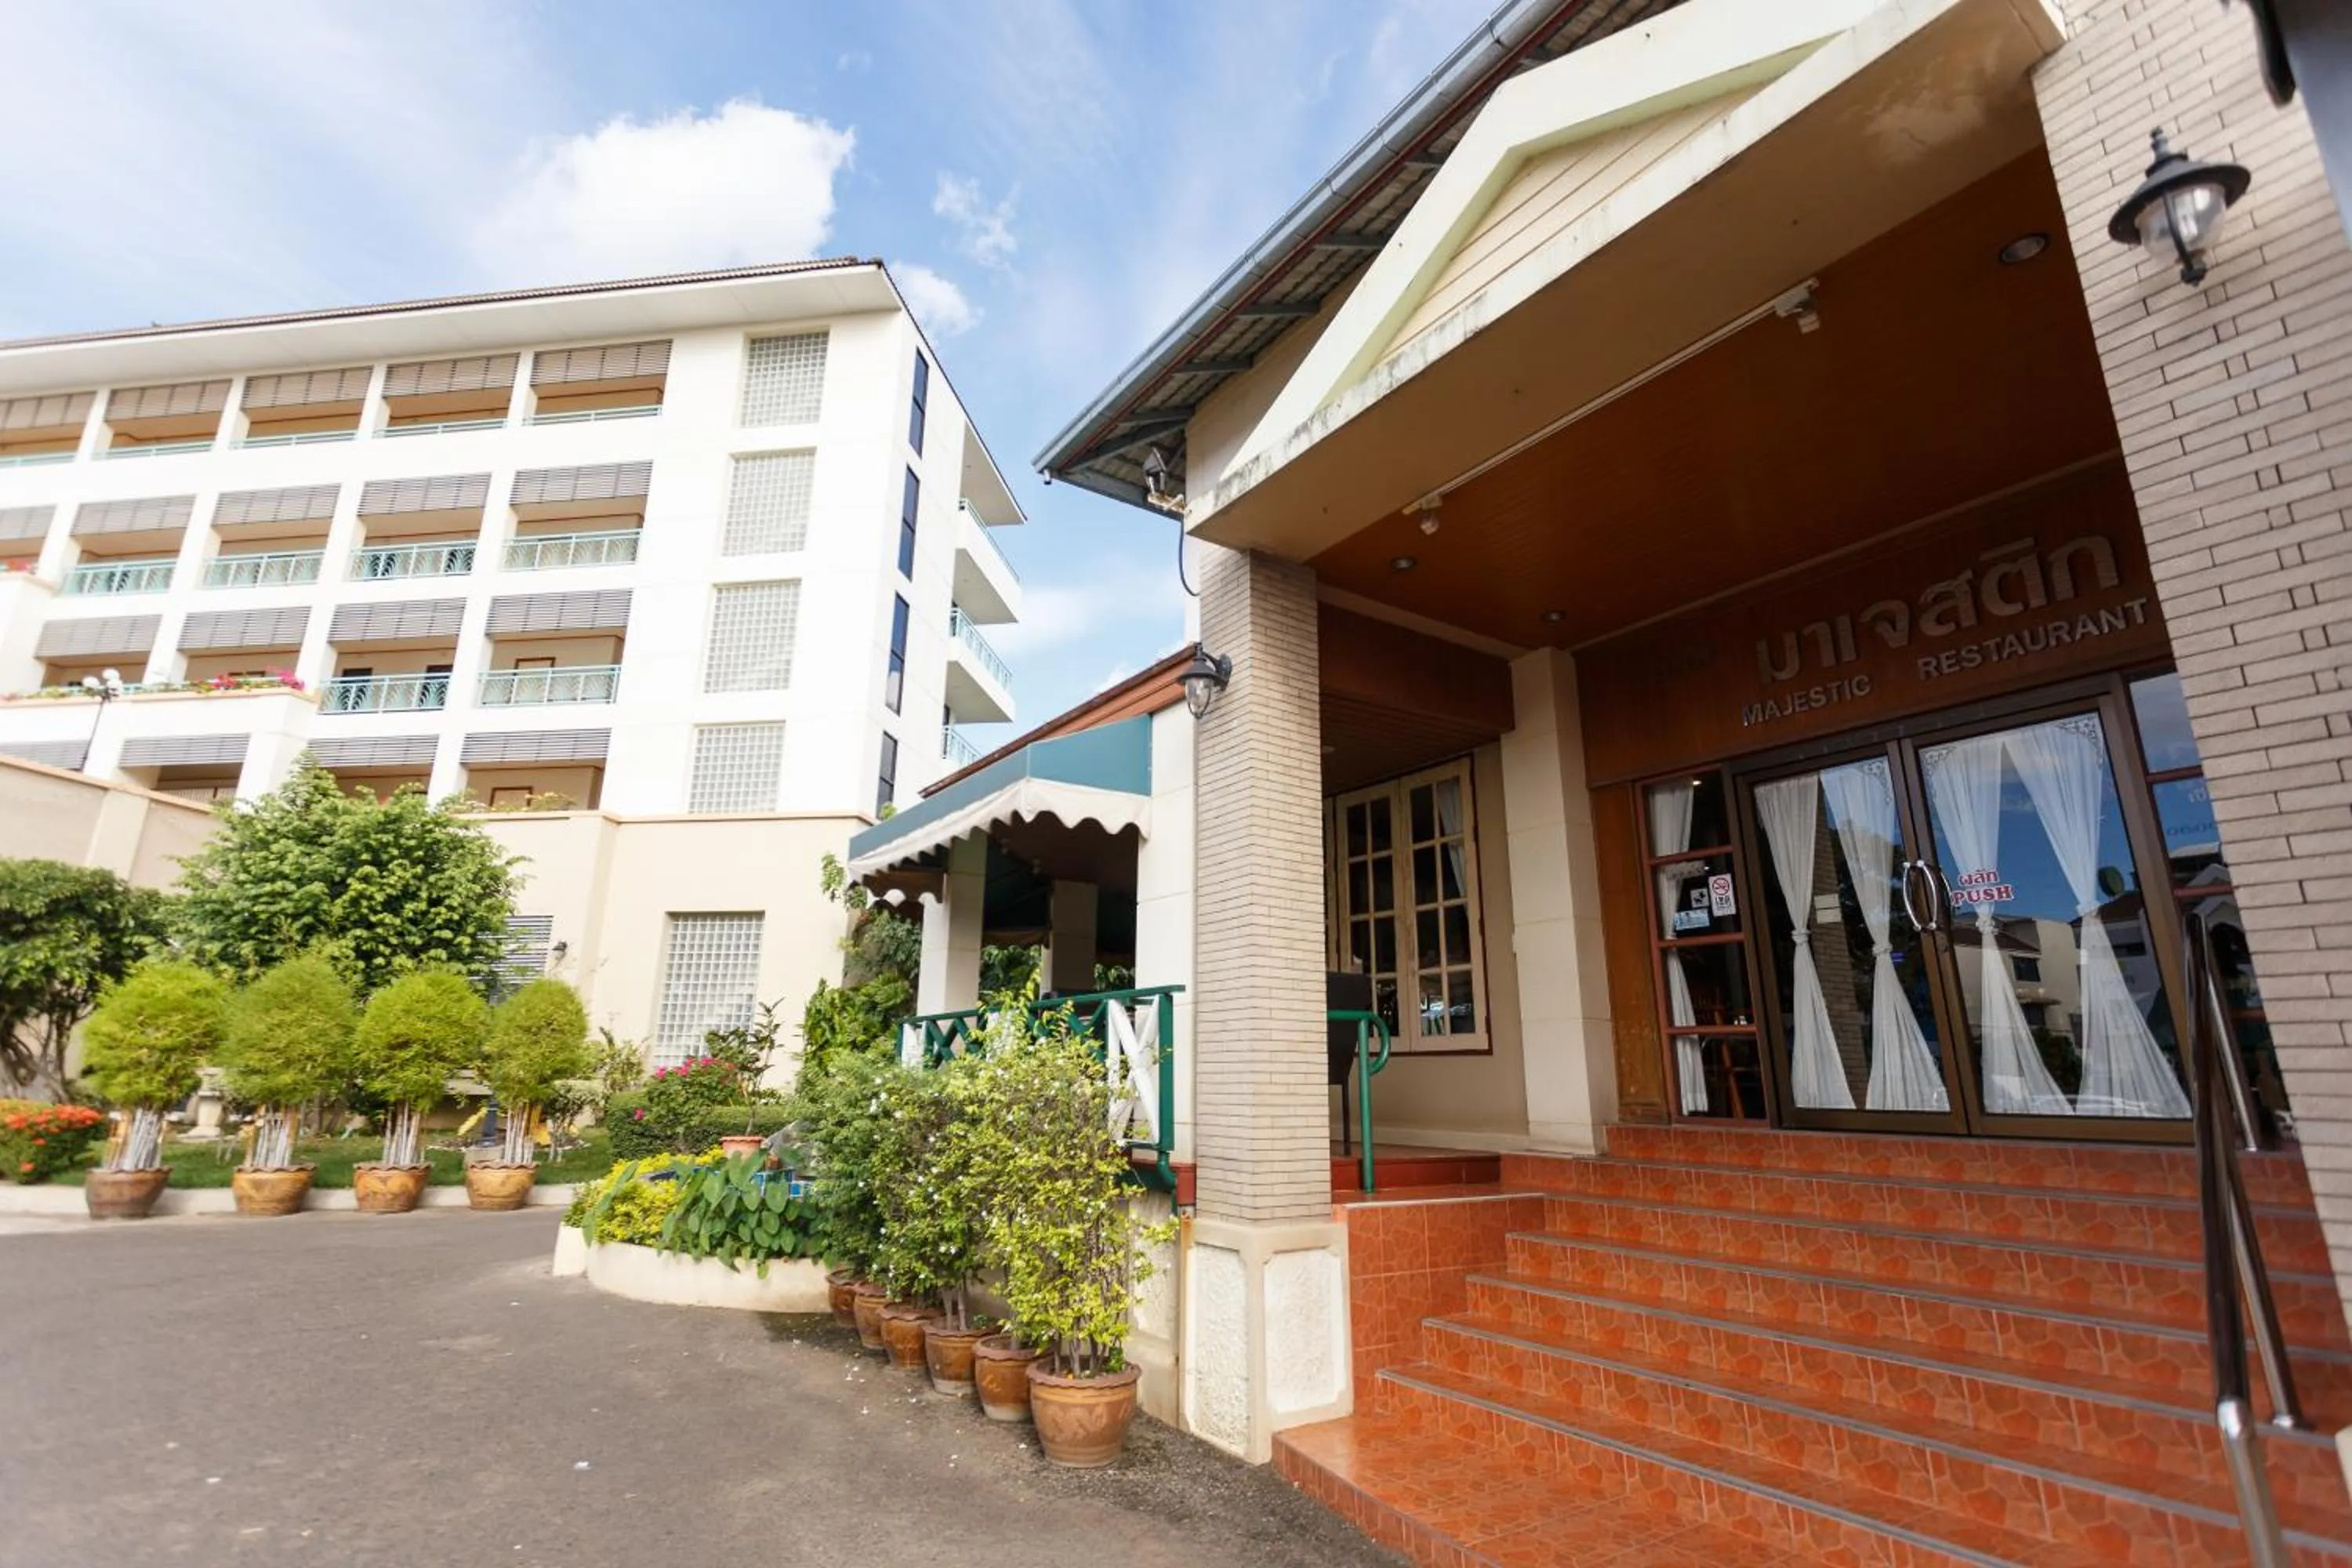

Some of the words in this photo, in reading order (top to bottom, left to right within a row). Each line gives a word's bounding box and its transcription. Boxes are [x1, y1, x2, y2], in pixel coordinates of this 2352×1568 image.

[1741, 674, 1871, 728] MAJESTIC
[1917, 597, 2149, 681] RESTAURANT
[1958, 868, 1998, 886] ผลัก
[1953, 885, 2012, 905] PUSH
